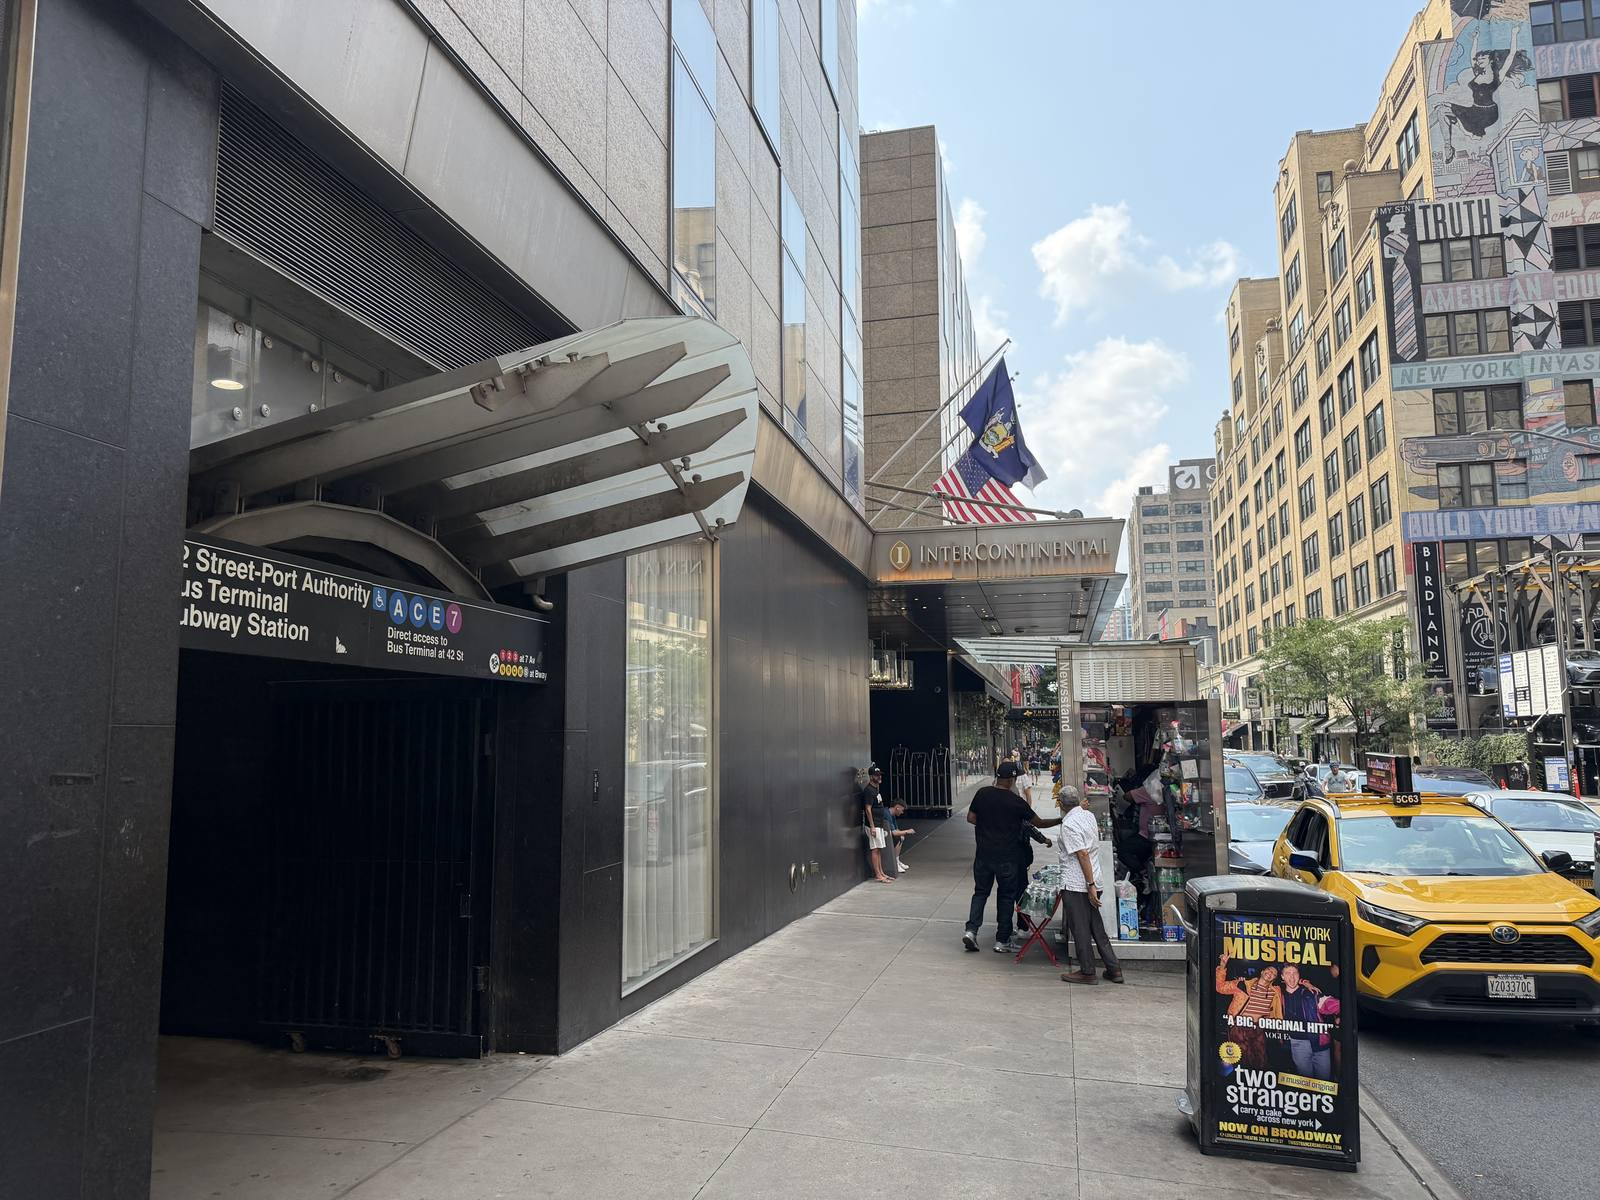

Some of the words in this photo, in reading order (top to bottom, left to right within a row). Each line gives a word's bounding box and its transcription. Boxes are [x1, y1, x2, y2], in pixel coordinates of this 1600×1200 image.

[1381, 206, 1392, 215] MY
[1395, 205, 1411, 213] SIN
[1419, 198, 1493, 240] TRUTH
[1551, 208, 1576, 222] CALL
[1423, 275, 1543, 313] AMERICAN
[1400, 365, 1448, 386] NEW
[1460, 359, 1516, 380] YORK
[1409, 511, 1471, 539] BUILD
[1478, 507, 1538, 535] YOUR
[1547, 504, 1600, 532] OWN
[196, 548, 297, 590] Street-Port
[302, 572, 371, 608] Authority
[207, 578, 289, 614] Terminal
[1422, 546, 1440, 662] BIRDLAND
[180, 603, 242, 638] ubway
[247, 613, 310, 642] Station
[387, 626, 412, 642] Direct
[413, 631, 439, 644] access
[440, 635, 448, 646] to
[387, 641, 404, 654] Bus
[404, 642, 437, 658] Terminal
[438, 648, 446, 659] at
[446, 649, 455, 660] 42
[456, 650, 464, 662] St
[1059, 661, 1073, 732] Newsstand
[1396, 795, 1419, 804] 5C63
[1223, 920, 1241, 935] THE
[1243, 922, 1277, 937] REAL
[1277, 924, 1302, 939] NEW
[1303, 926, 1331, 942] YORK
[1223, 936, 1332, 966] MUSICAL
[1489, 981, 1532, 993] Y203370C
[1236, 1015, 1257, 1030] BIG,
[1258, 1017, 1306, 1033] ORIGINAL
[1264, 1031, 1290, 1041] VOGUE
[1234, 1064, 1277, 1090] two
[1286, 1077, 1311, 1088] musical
[1311, 1081, 1336, 1092] original
[1226, 1084, 1334, 1115] strangers
[1240, 1106, 1258, 1116] carry
[1265, 1108, 1282, 1118] cake
[1256, 1115, 1280, 1124] across
[1281, 1117, 1297, 1126] new
[1298, 1118, 1314, 1130] york
[1219, 1121, 1248, 1134] NOW
[1250, 1124, 1268, 1137] ON
[1271, 1127, 1342, 1144] BROADWAY
